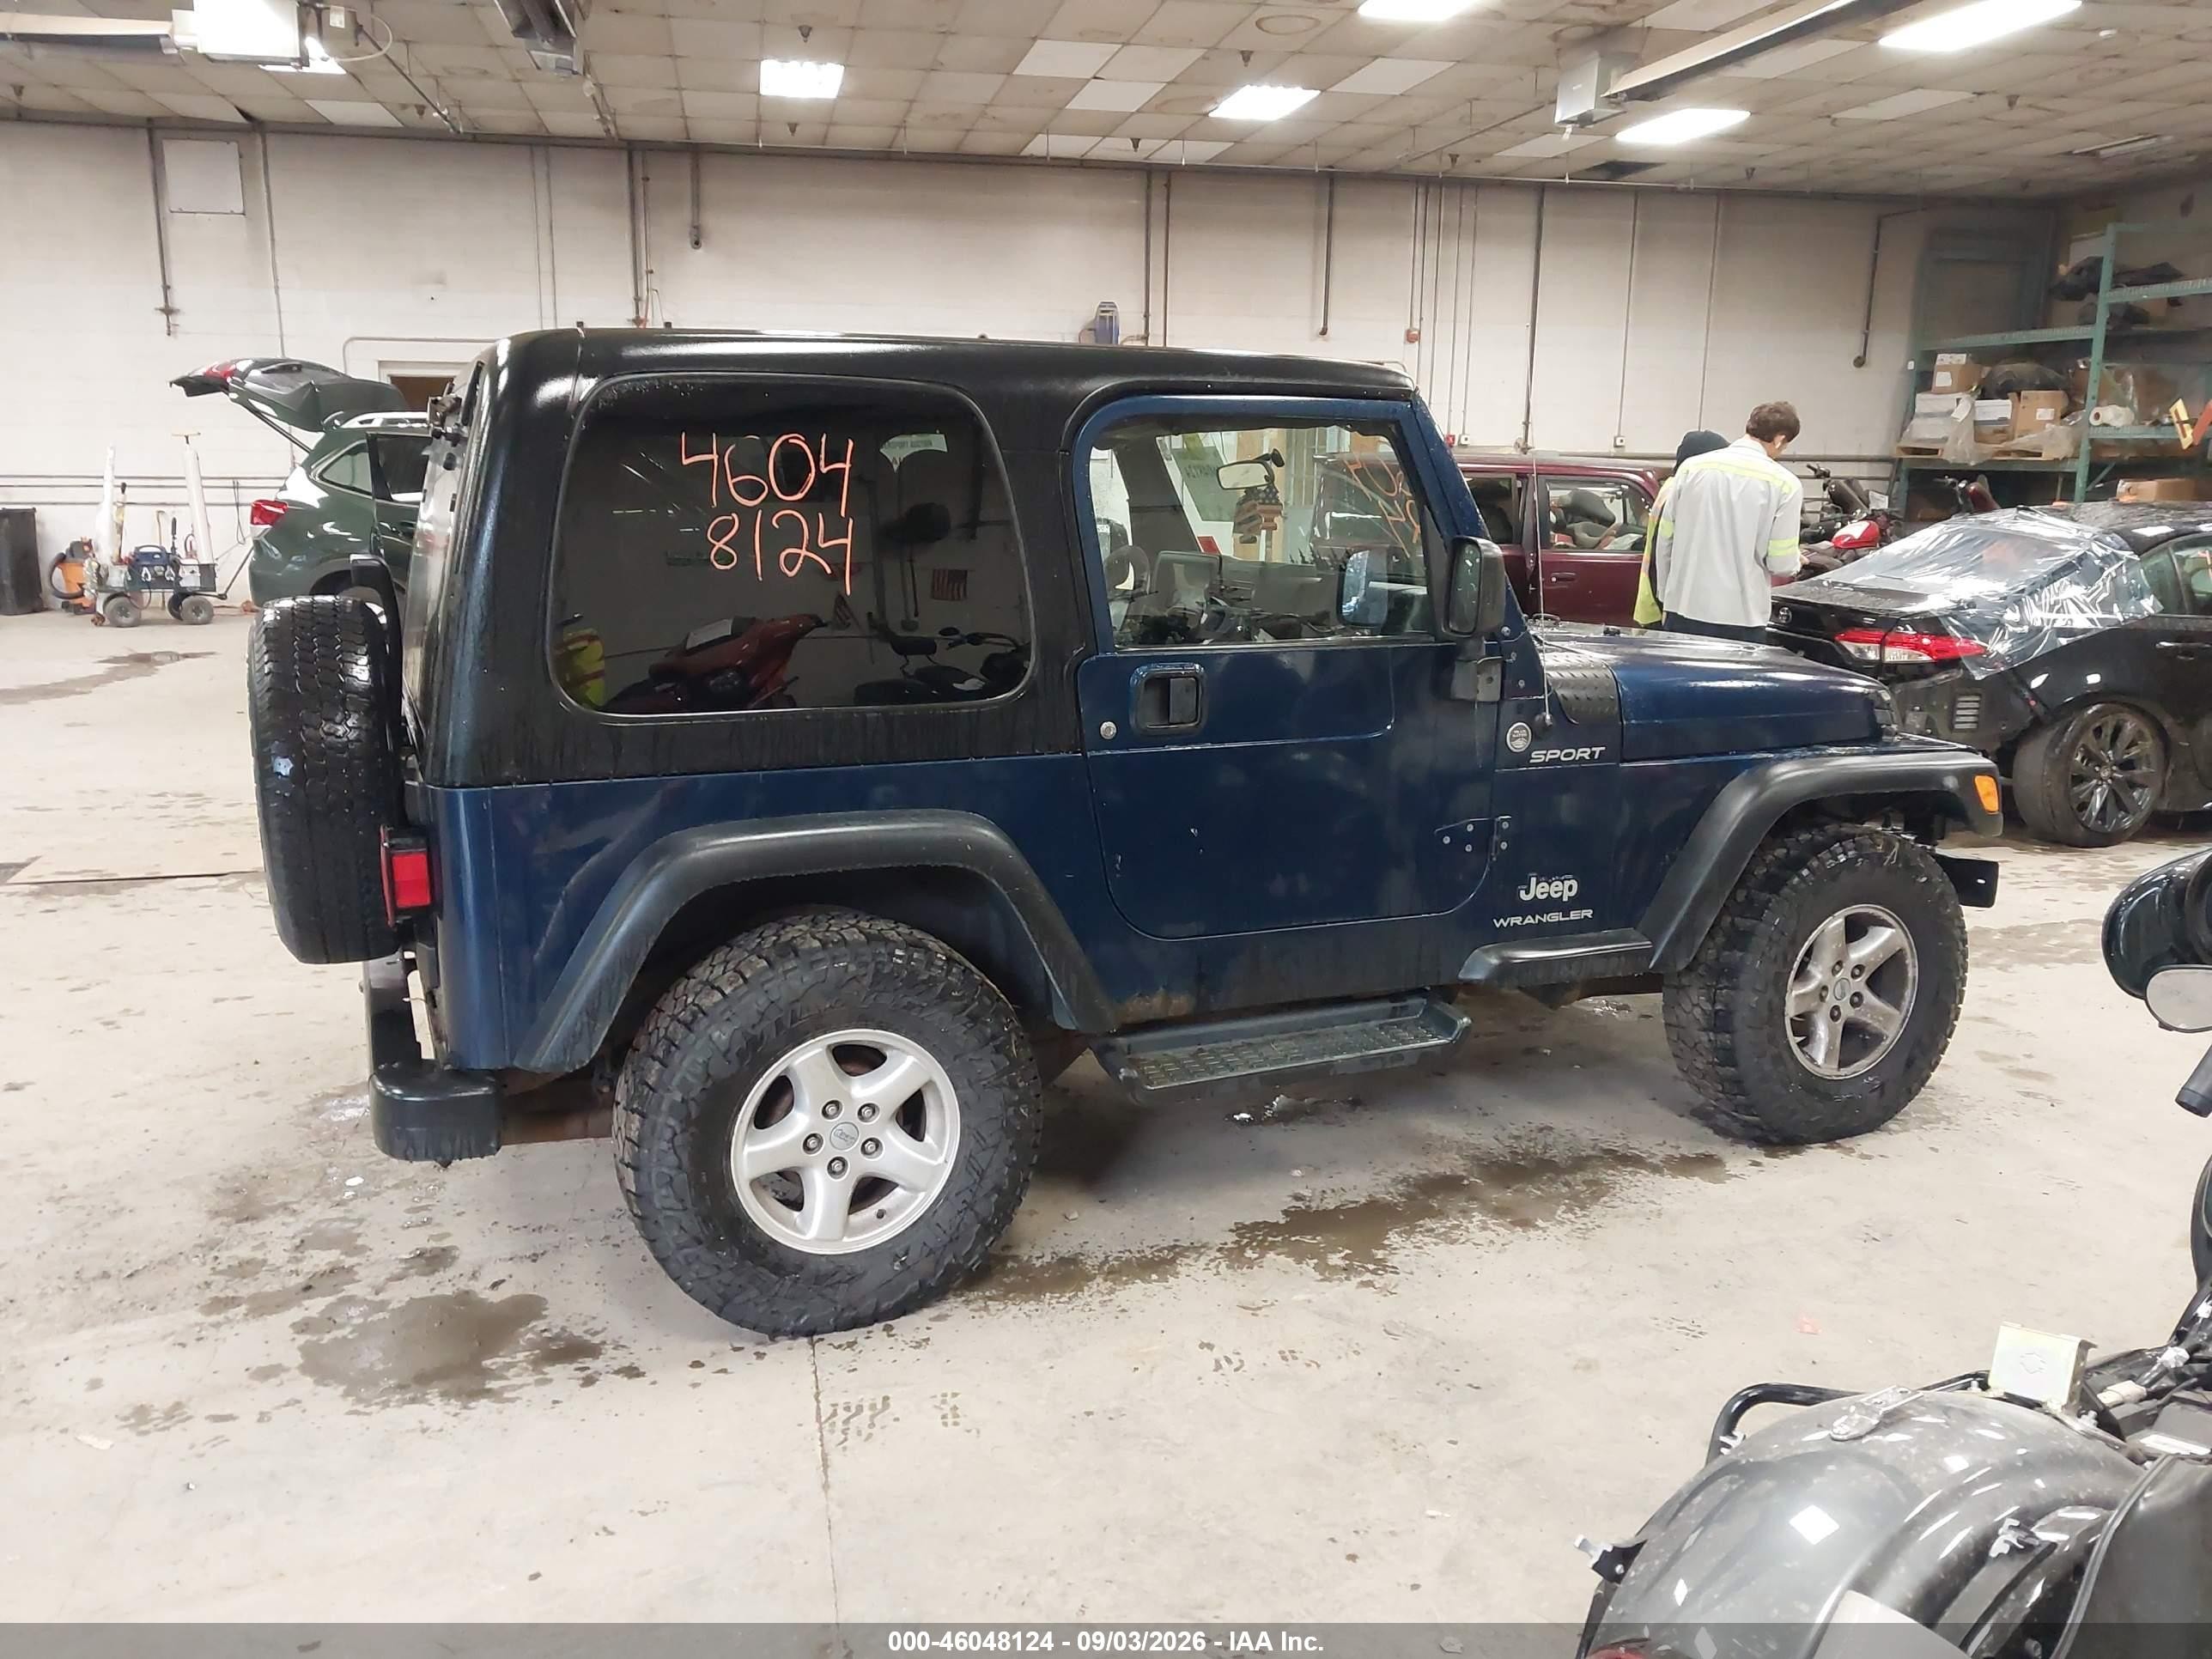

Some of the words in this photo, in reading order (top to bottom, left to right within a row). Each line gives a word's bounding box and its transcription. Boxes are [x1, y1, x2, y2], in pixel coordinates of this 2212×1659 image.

[681, 433, 854, 518] 4604
[706, 509, 854, 596] 8124
[1528, 745, 1607, 763] SPORT
[1518, 874, 1578, 902] Jeep
[1493, 908, 1594, 929] WRANGLER
